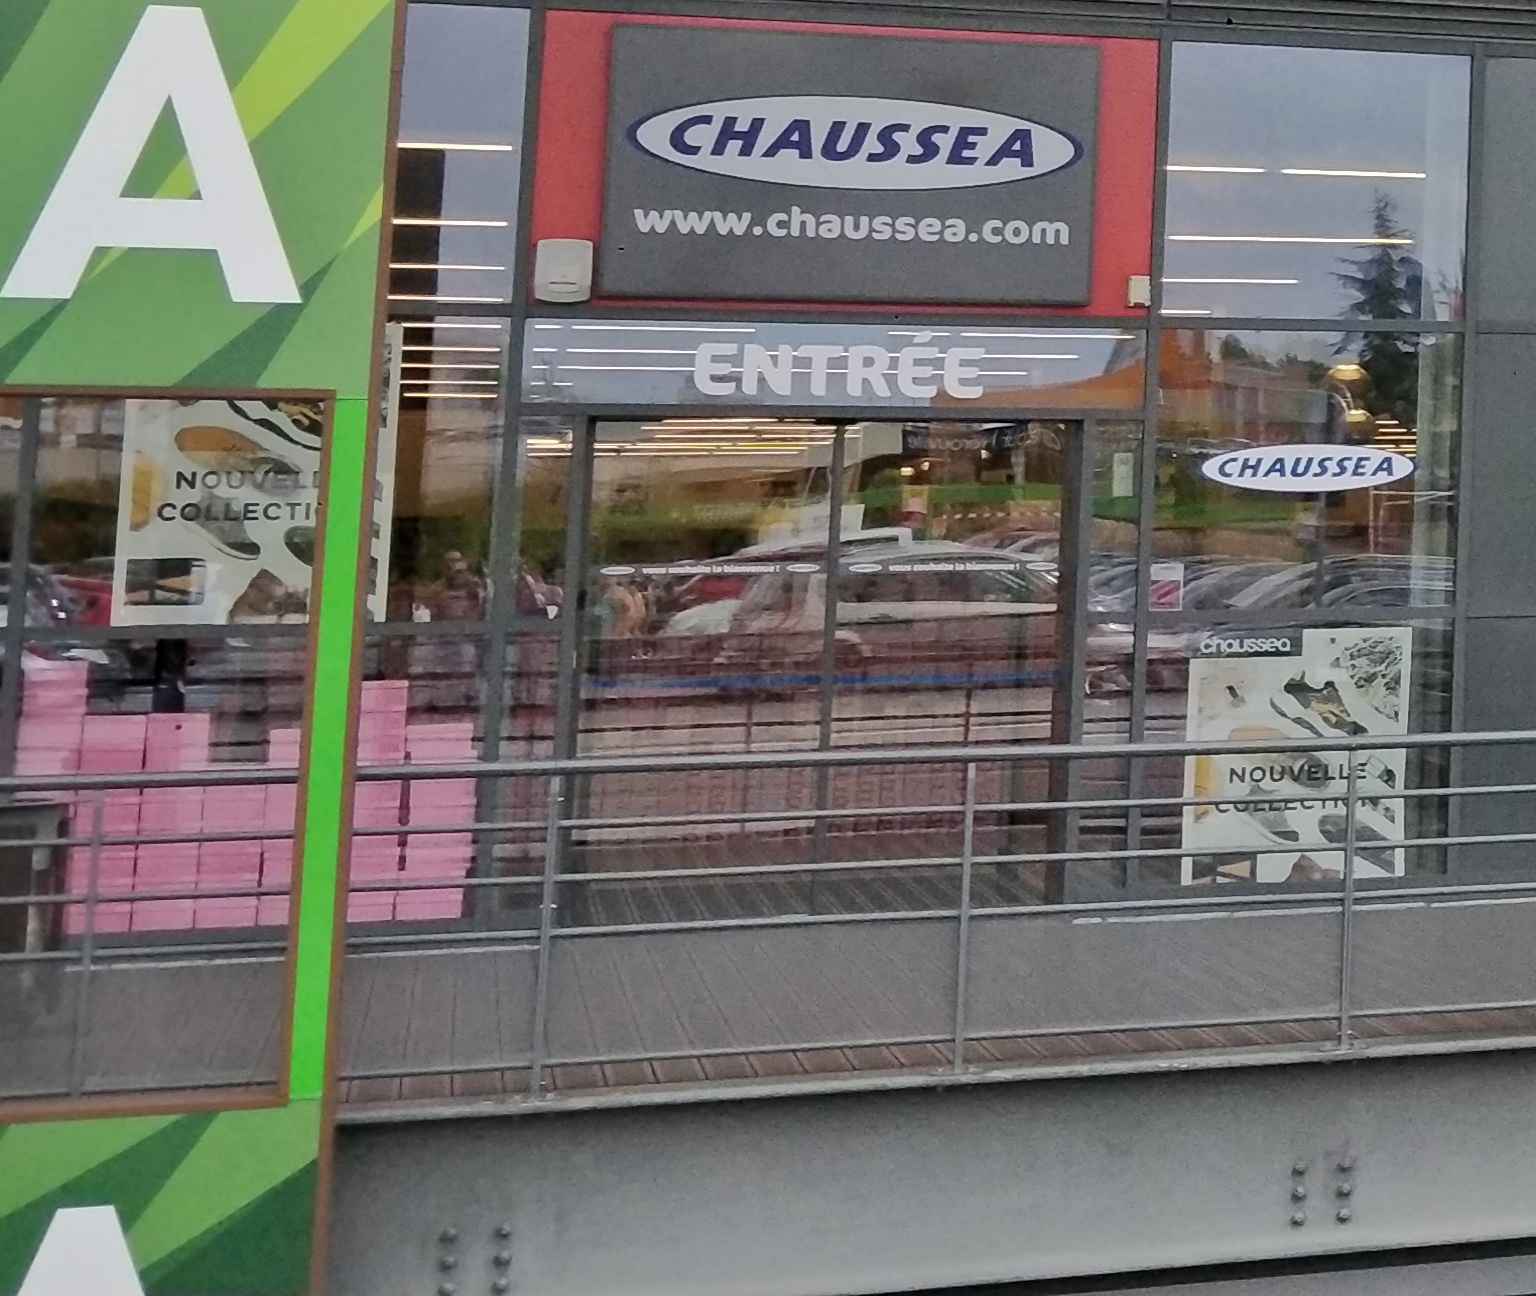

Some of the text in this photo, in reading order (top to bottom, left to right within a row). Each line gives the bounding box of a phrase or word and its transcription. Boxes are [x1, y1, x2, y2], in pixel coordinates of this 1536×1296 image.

[0, 5, 302, 303] A
[669, 115, 1035, 168] CHAUSSEA
[634, 206, 1069, 245] www.chaussea.com
[693, 330, 986, 400] ENTRÉE
[175, 471, 319, 490] NOUVELL
[1218, 456, 1395, 478] CHAUSSEA
[157, 503, 320, 522] COLLECTI
